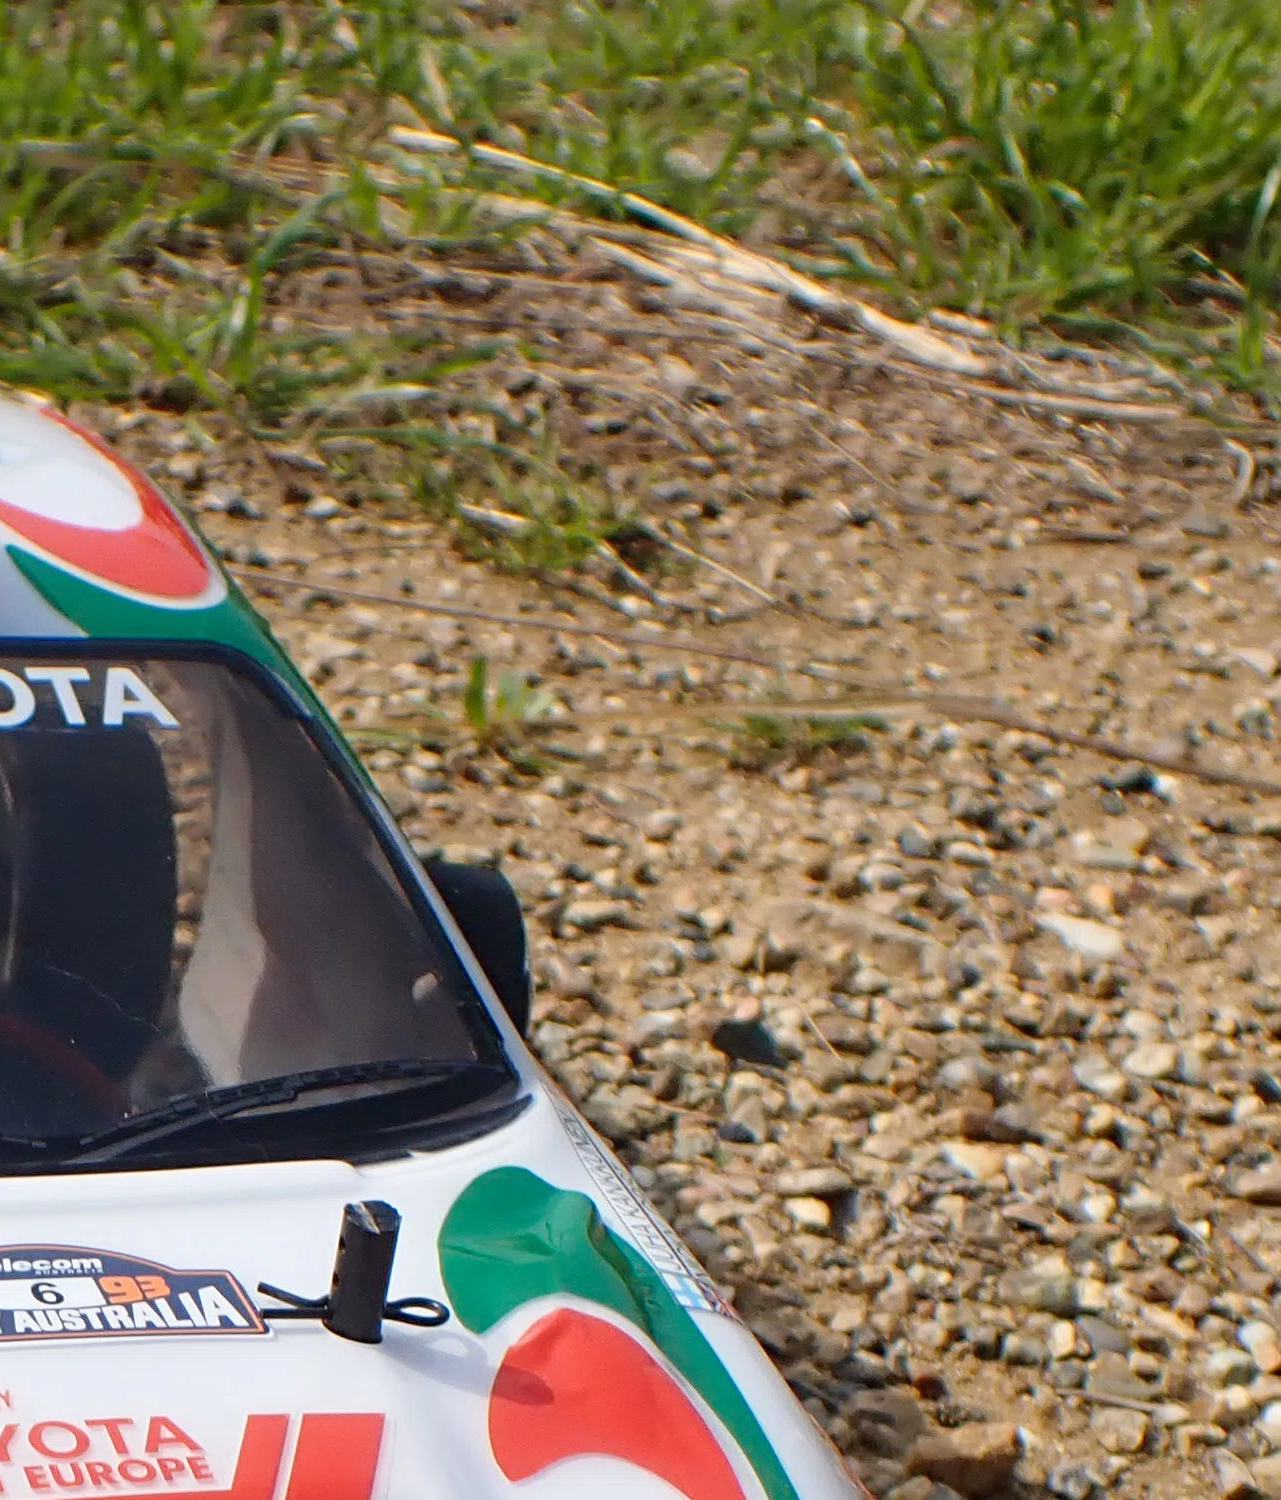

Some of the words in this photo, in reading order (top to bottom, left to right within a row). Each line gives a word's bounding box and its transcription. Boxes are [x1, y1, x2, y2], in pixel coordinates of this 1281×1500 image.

[30, 1282, 65, 1306] 6
[99, 1274, 172, 1304] 93
[13, 1285, 250, 1334] AUSTRALIA
[27, 1456, 214, 1491] EUROPE
